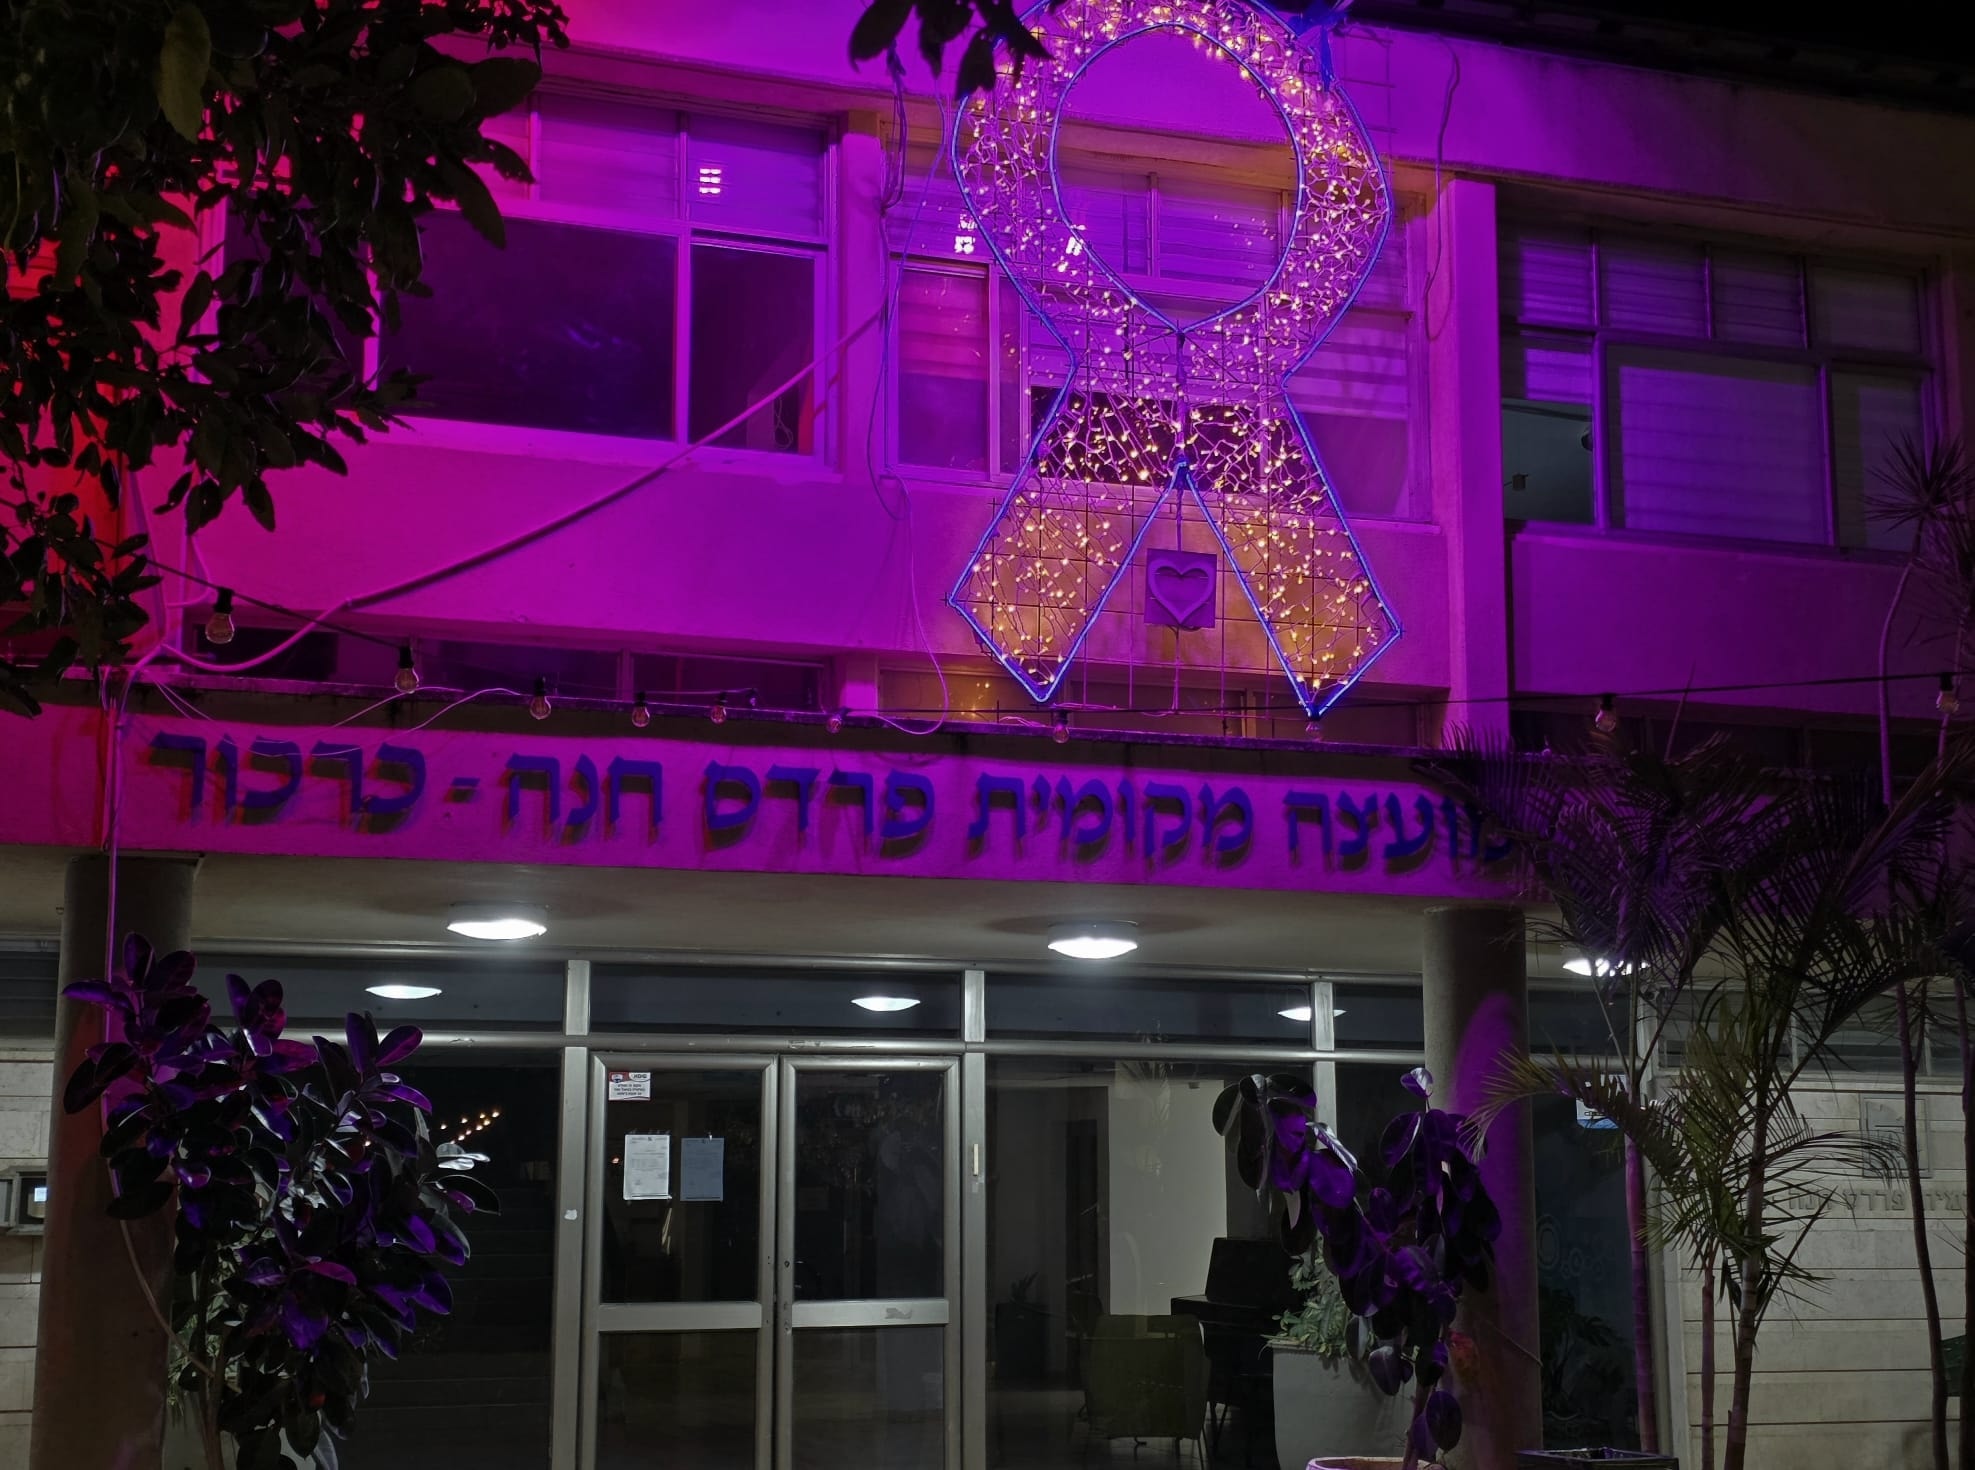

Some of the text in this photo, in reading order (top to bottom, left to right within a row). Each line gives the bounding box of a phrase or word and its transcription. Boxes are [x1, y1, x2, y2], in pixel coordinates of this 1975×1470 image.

[149, 731, 426, 816] כרכור
[505, 752, 664, 827] חנה
[704, 759, 936, 839] פרדס
[967, 773, 1254, 858] מקומית
